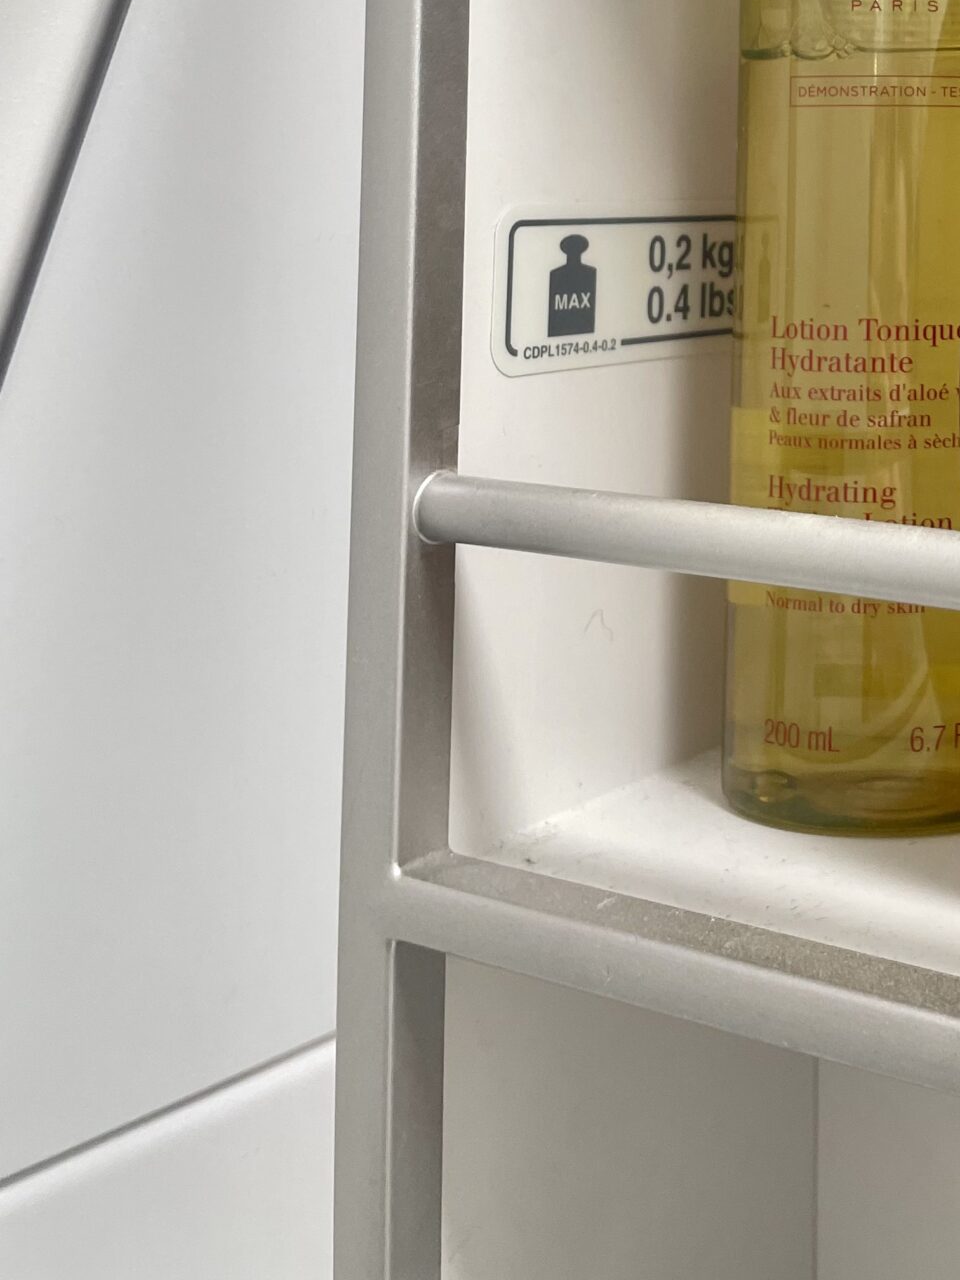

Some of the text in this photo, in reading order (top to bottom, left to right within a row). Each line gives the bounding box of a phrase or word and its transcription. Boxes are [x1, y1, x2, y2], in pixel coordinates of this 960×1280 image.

[851, 0, 939, 12] PARIS
[798, 82, 927, 97] DÉMONSTRATION
[649, 233, 734, 279] 0,2 kg
[554, 292, 591, 310] MAX
[647, 283, 690, 323] 0.4
[770, 316, 848, 341] Lotion
[523, 338, 617, 360] CDPL1574-0.4-0.2
[770, 347, 914, 377] Hydratante
[769, 382, 801, 400] Aux
[808, 384, 882, 402] extraits
[889, 383, 950, 402] d'aloé
[769, 406, 932, 428] & fleur de safran
[769, 429, 812, 449] Peaux
[818, 435, 902, 451] normales
[908, 435, 917, 450] à
[768, 475, 897, 510] Hydrating
[766, 589, 823, 613] Normal
[829, 598, 846, 614] to
[851, 598, 881, 618] dry
[764, 718, 841, 753] 200 mL
[909, 725, 946, 752] 6.7
